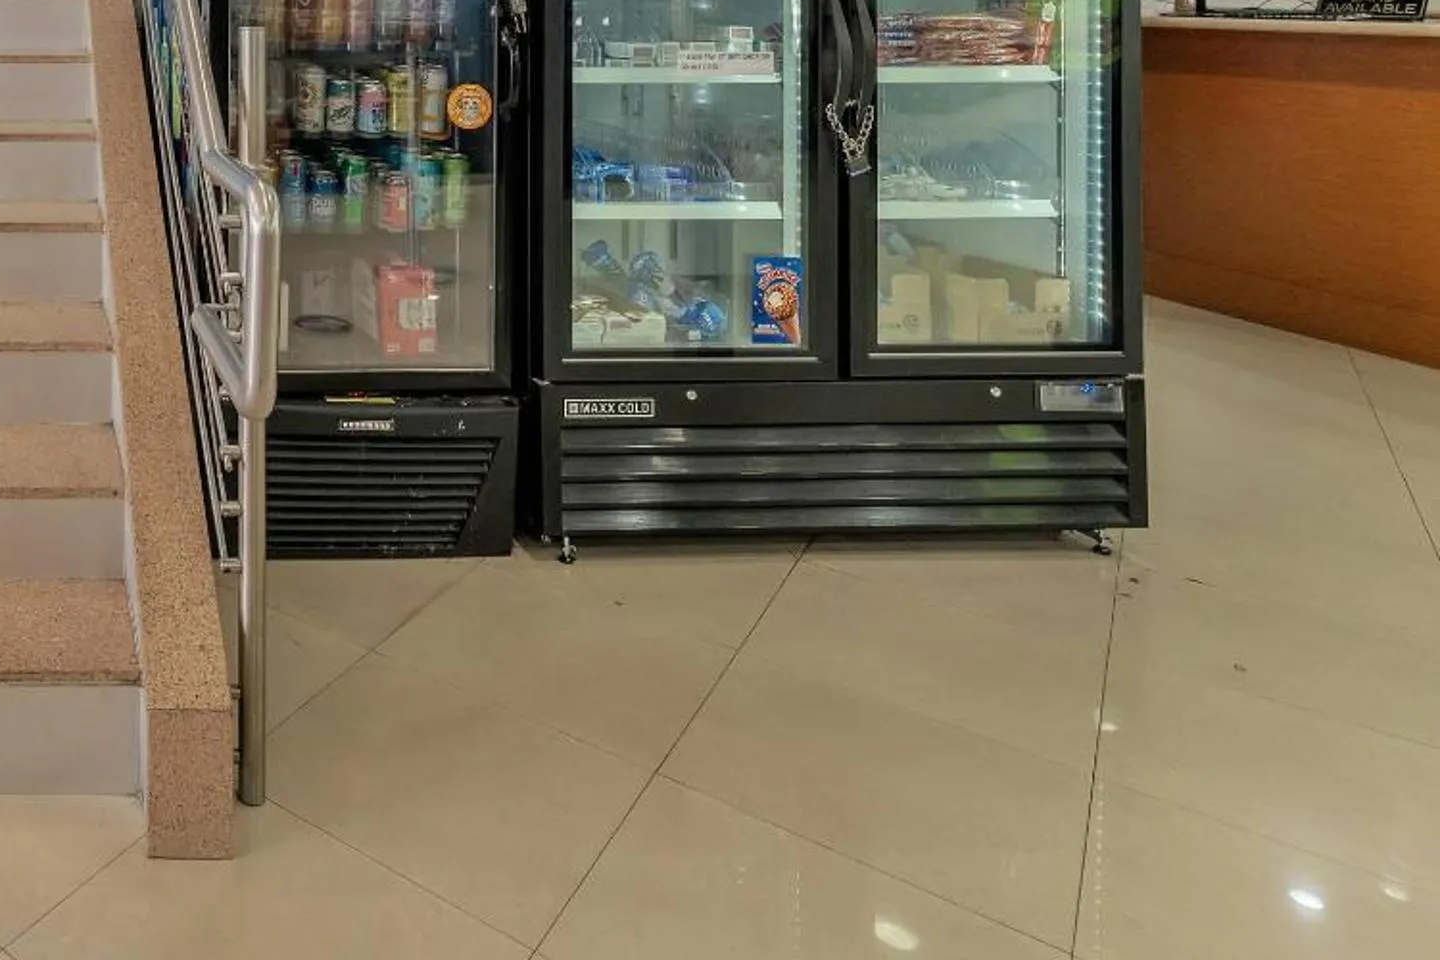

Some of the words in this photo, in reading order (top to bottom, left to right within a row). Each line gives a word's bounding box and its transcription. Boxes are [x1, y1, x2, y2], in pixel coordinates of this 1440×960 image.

[1324, 3, 1418, 15] AVAILABLE
[580, 402, 616, 414] MAXX
[617, 402, 650, 414] COLD
